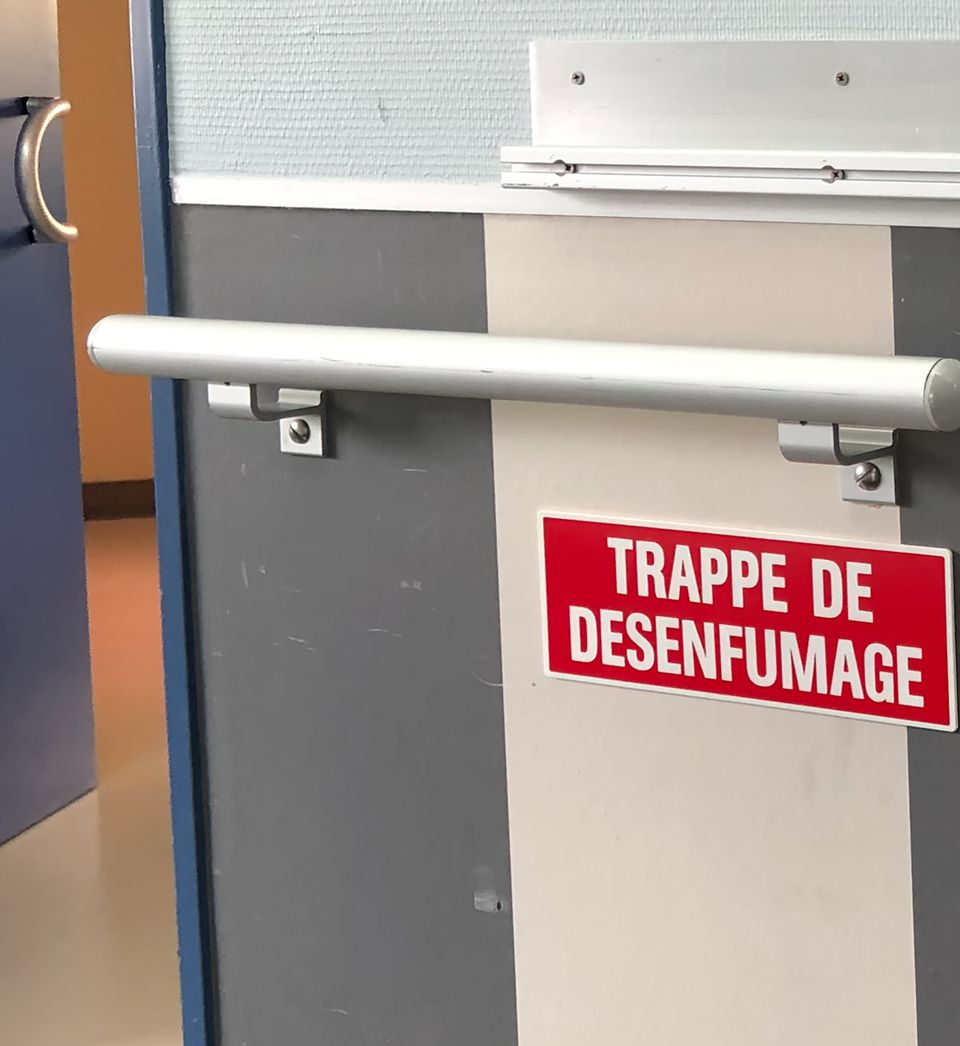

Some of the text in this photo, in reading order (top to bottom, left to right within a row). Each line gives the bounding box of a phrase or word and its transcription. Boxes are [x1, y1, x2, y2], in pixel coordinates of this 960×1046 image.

[607, 536, 875, 624] TRAPPE DE
[569, 605, 925, 708] DESENFUMAGE
